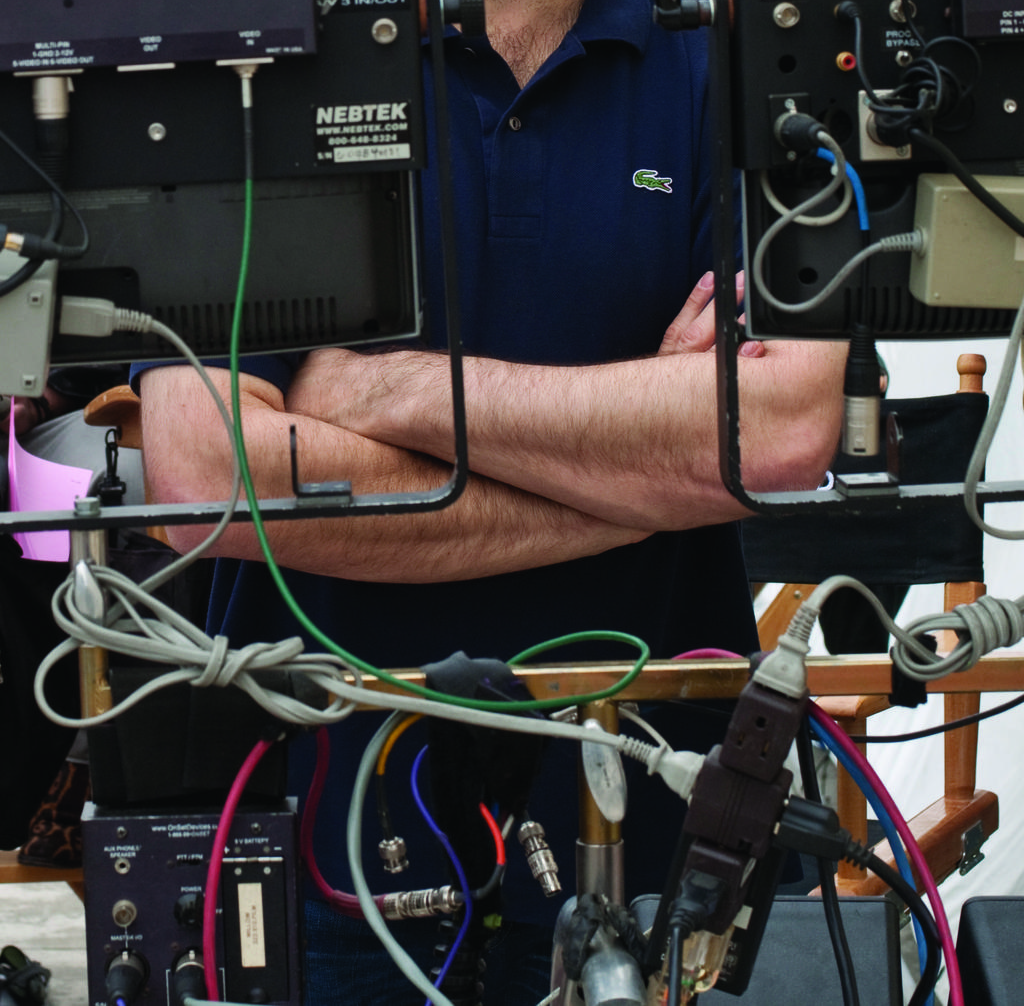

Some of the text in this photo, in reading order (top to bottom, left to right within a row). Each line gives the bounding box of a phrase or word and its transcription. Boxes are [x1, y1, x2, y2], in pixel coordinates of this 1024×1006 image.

[238, 30, 261, 38] VIDEO
[886, 30, 912, 39] PROC
[139, 35, 162, 44] VIDEO
[143, 44, 159, 52] OUT
[316, 102, 408, 124] NEBTEK
[316, 122, 408, 135] WWW.NEBTEK.COM
